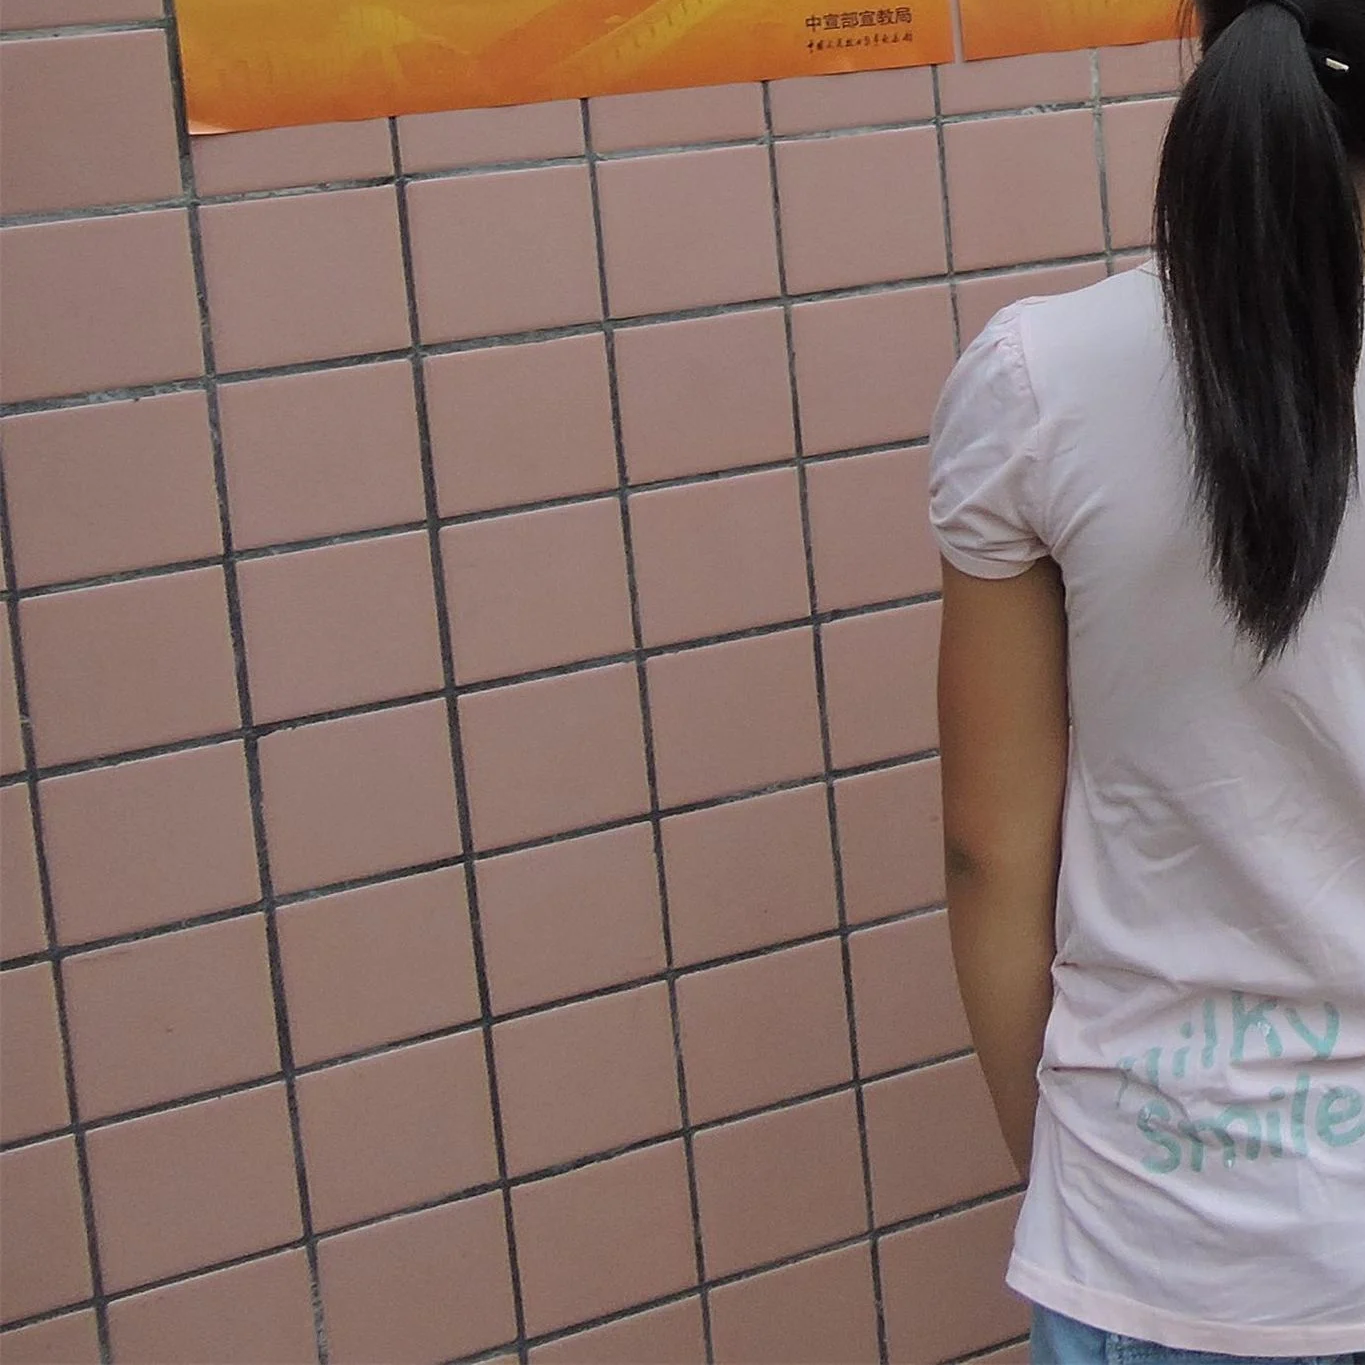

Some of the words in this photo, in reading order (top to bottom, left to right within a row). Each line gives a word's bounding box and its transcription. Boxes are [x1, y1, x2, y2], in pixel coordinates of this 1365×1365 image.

[805, 7, 912, 32] 中宣部宣教局
